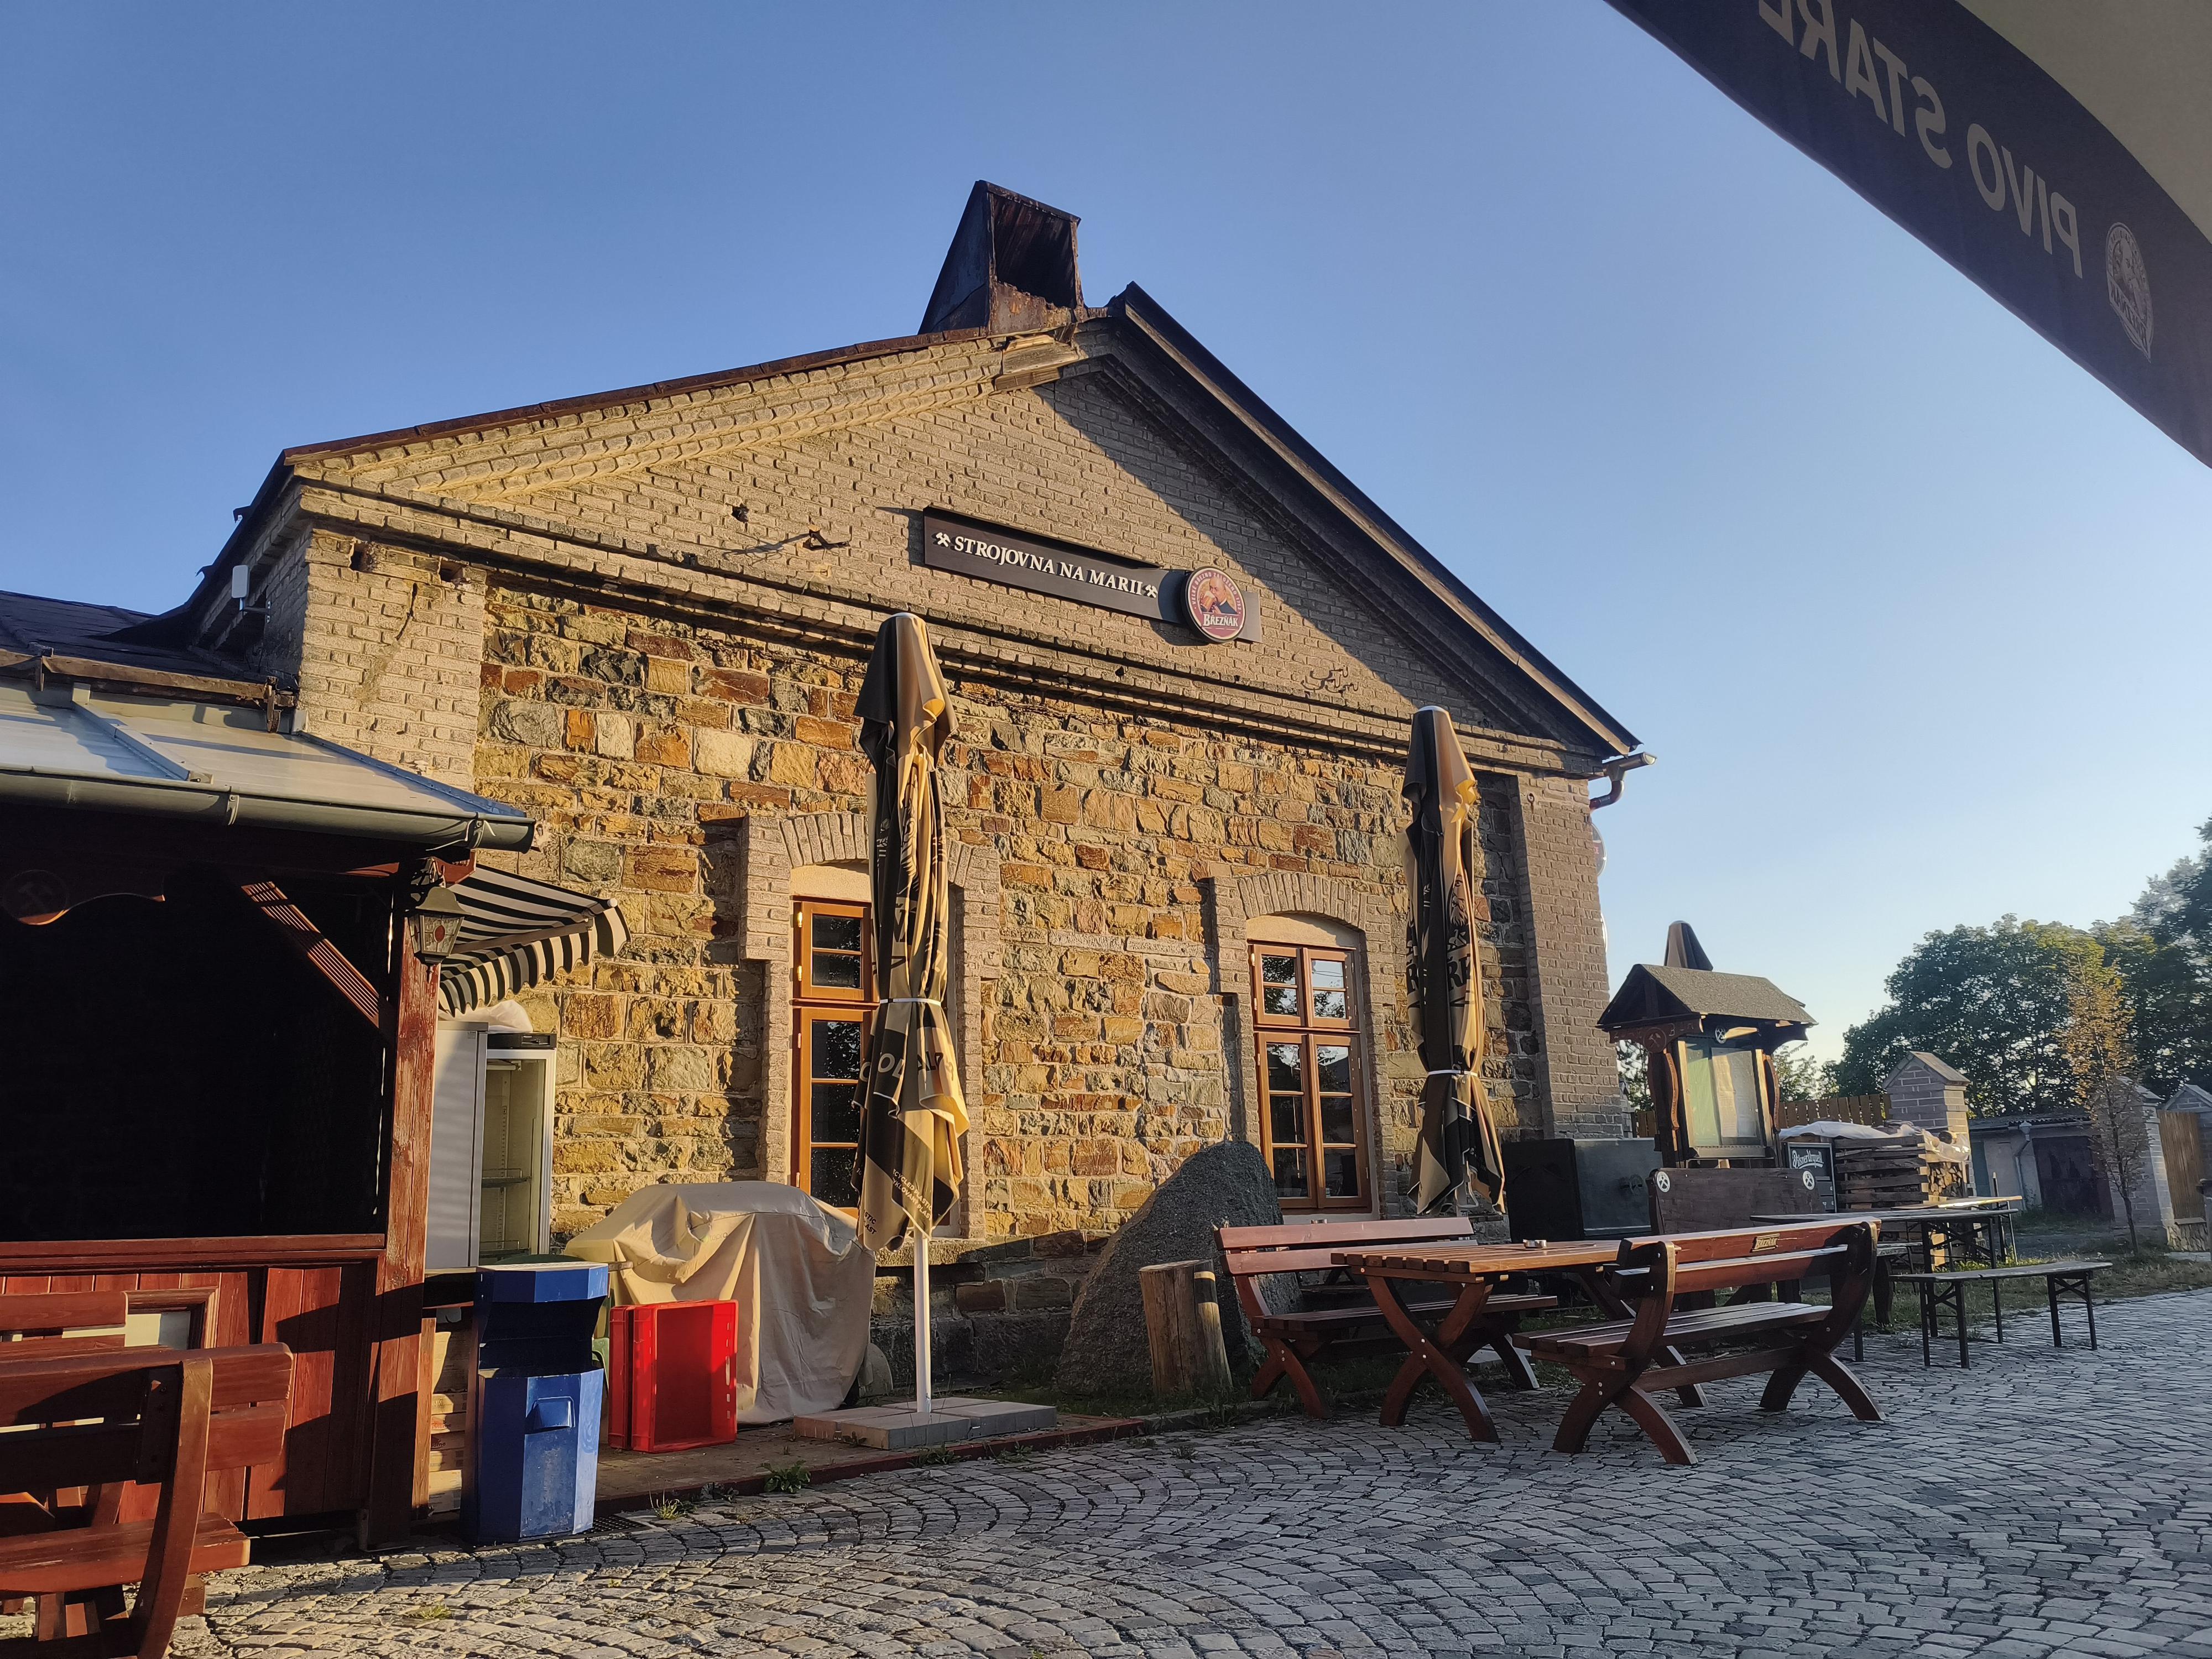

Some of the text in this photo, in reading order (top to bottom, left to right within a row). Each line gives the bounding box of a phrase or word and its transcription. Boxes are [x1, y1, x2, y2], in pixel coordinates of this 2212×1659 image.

[954, 536, 1143, 595] STROJOVNA NA MARII
[1203, 613, 1238, 627] BŘEZŇÁK
